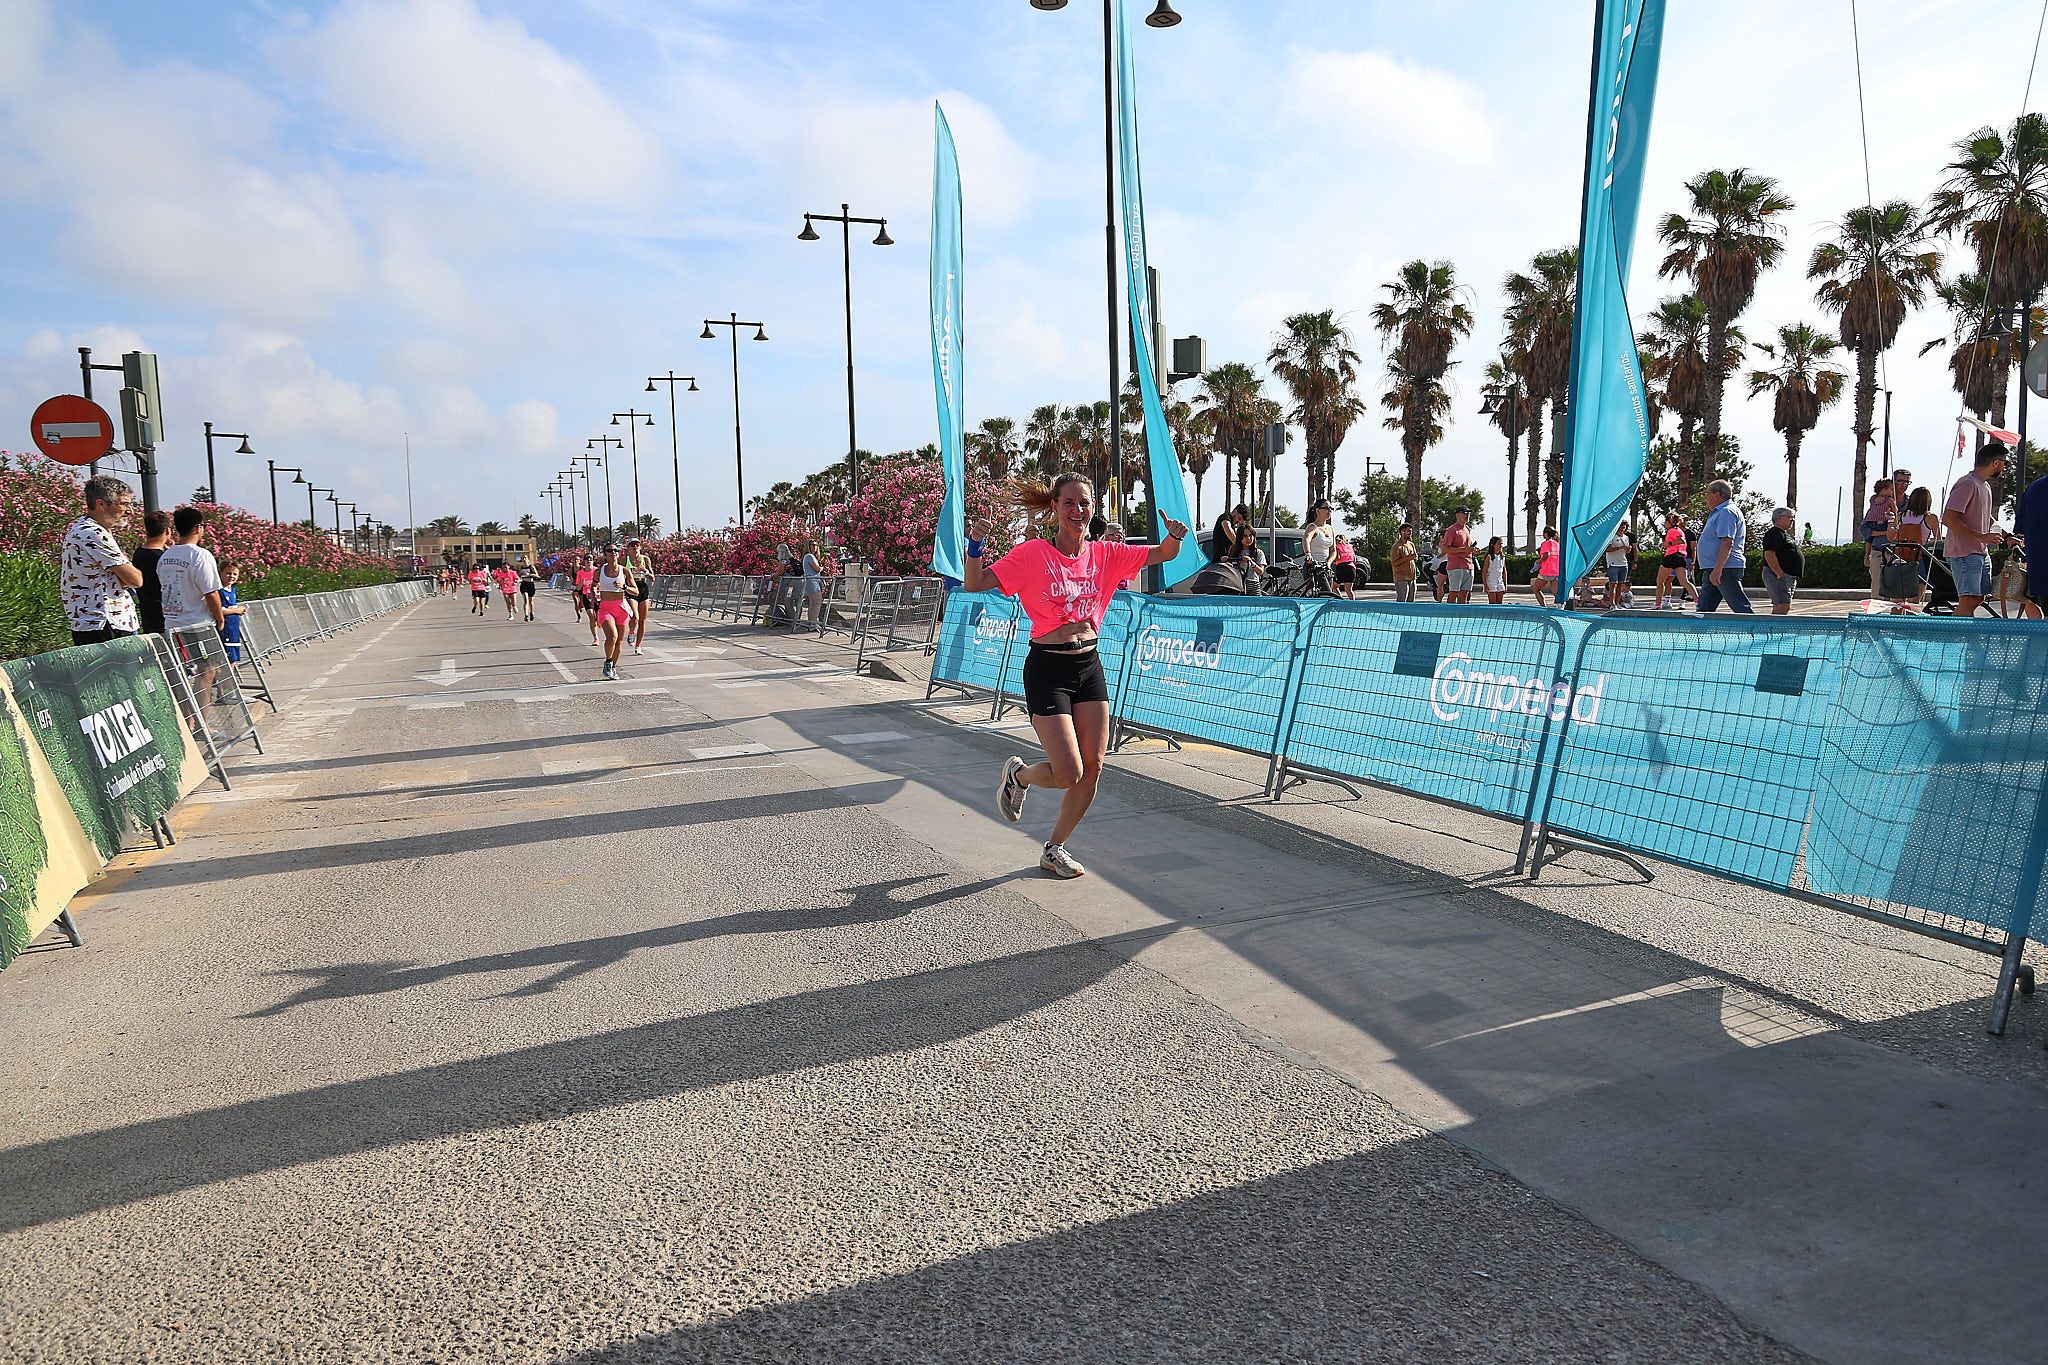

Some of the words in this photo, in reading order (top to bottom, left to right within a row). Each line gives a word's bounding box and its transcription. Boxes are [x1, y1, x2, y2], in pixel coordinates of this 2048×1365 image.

[1621, 351, 1637, 395] sanitarios.
[1632, 396, 1647, 436] productos
[1641, 439, 1647, 450] de
[1137, 624, 1224, 671] Compeed
[1430, 651, 1604, 726] Compeed
[36, 708, 53, 730] 1975
[1475, 730, 1532, 752] AMPOLLAS
